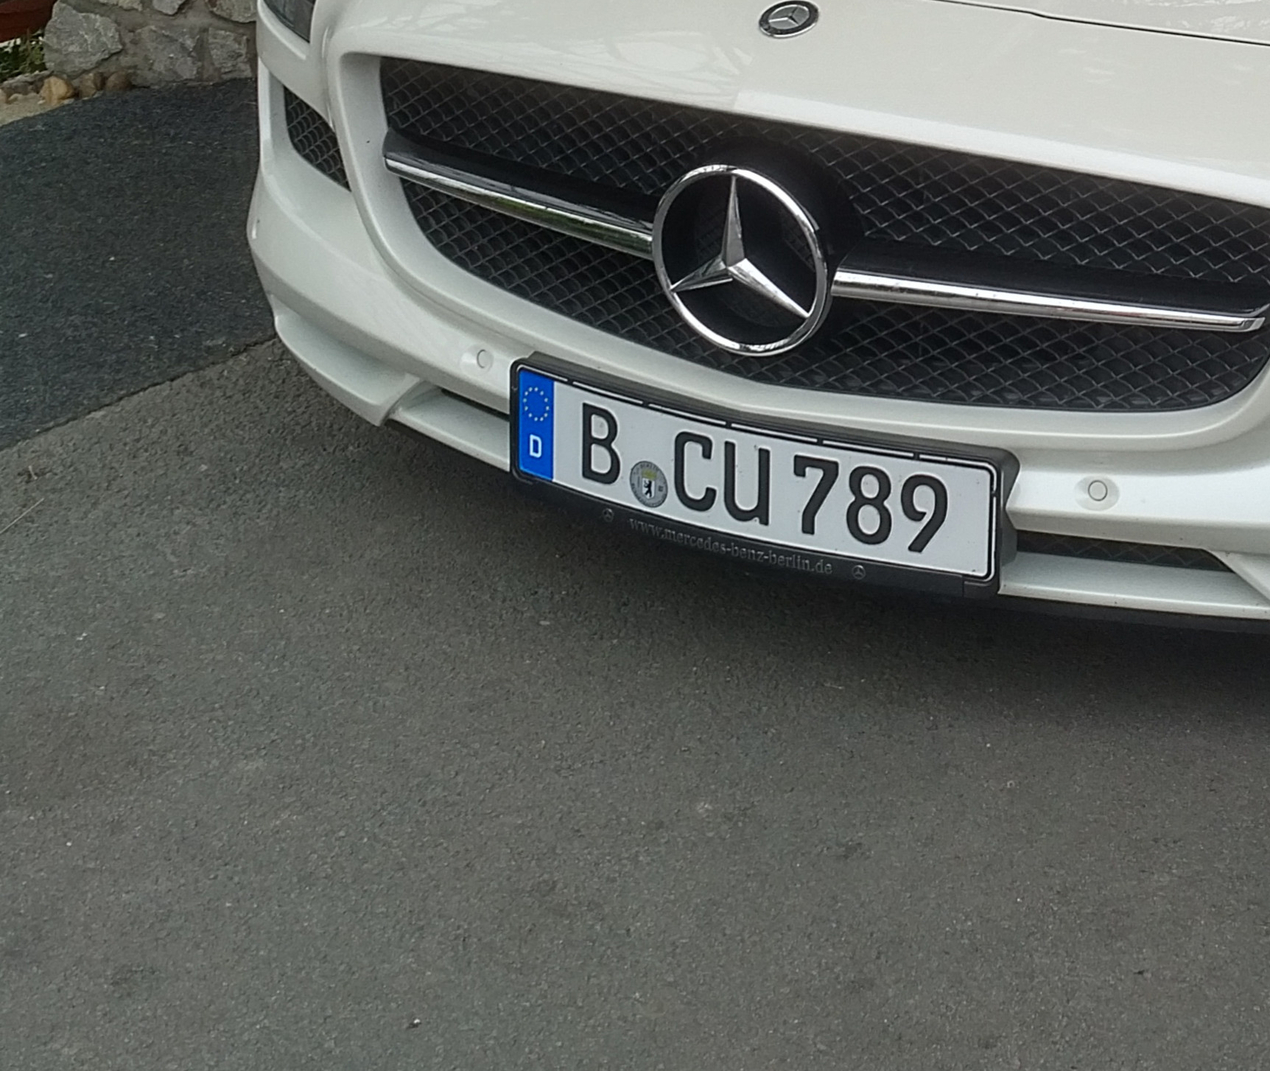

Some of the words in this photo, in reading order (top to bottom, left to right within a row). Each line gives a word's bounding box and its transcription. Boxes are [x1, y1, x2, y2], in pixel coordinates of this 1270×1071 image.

[528, 434, 542, 459] D
[581, 403, 621, 485] B
[673, 430, 771, 527] CU
[793, 454, 949, 554] 789
[628, 518, 834, 576] www.mercedes-benz-berlin.de
